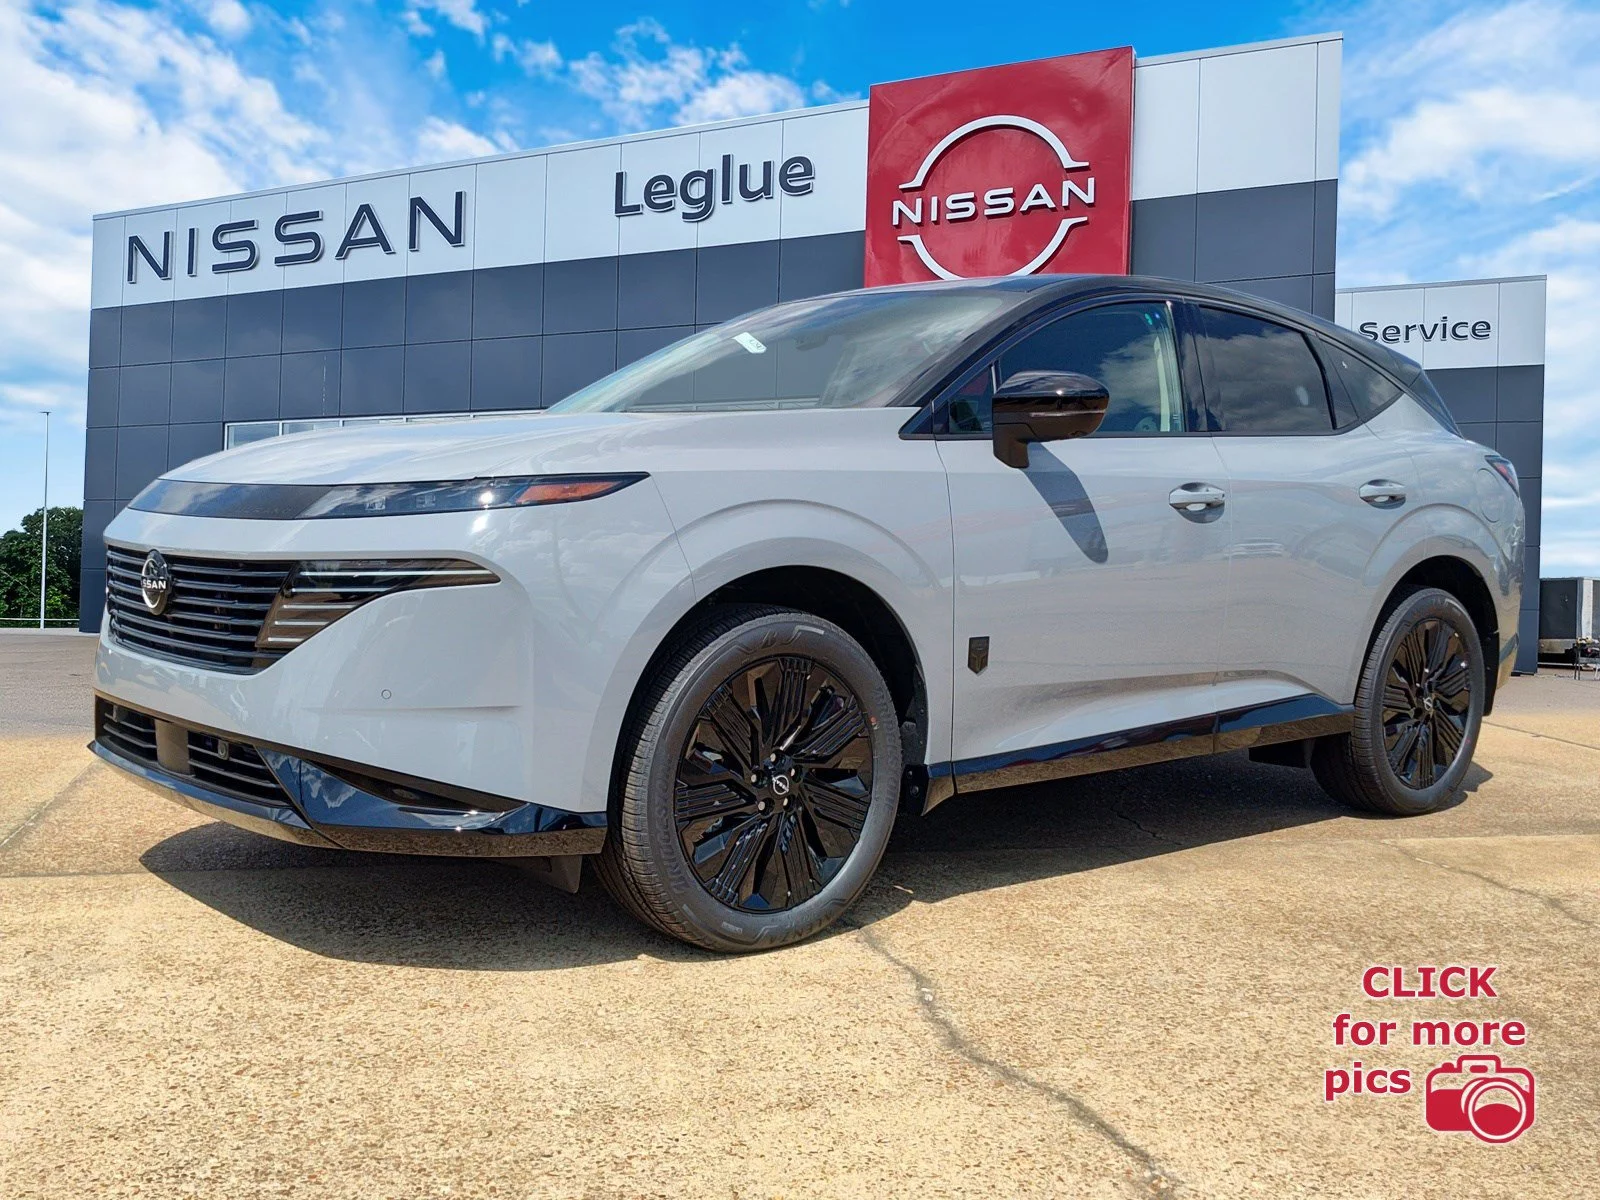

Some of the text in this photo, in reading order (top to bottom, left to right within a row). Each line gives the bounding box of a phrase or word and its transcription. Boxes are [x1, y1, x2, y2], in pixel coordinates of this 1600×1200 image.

[614, 152, 815, 222] Leglue
[892, 177, 1096, 226] NISSAN
[127, 190, 466, 283] NISSAN
[1359, 316, 1492, 343] Service
